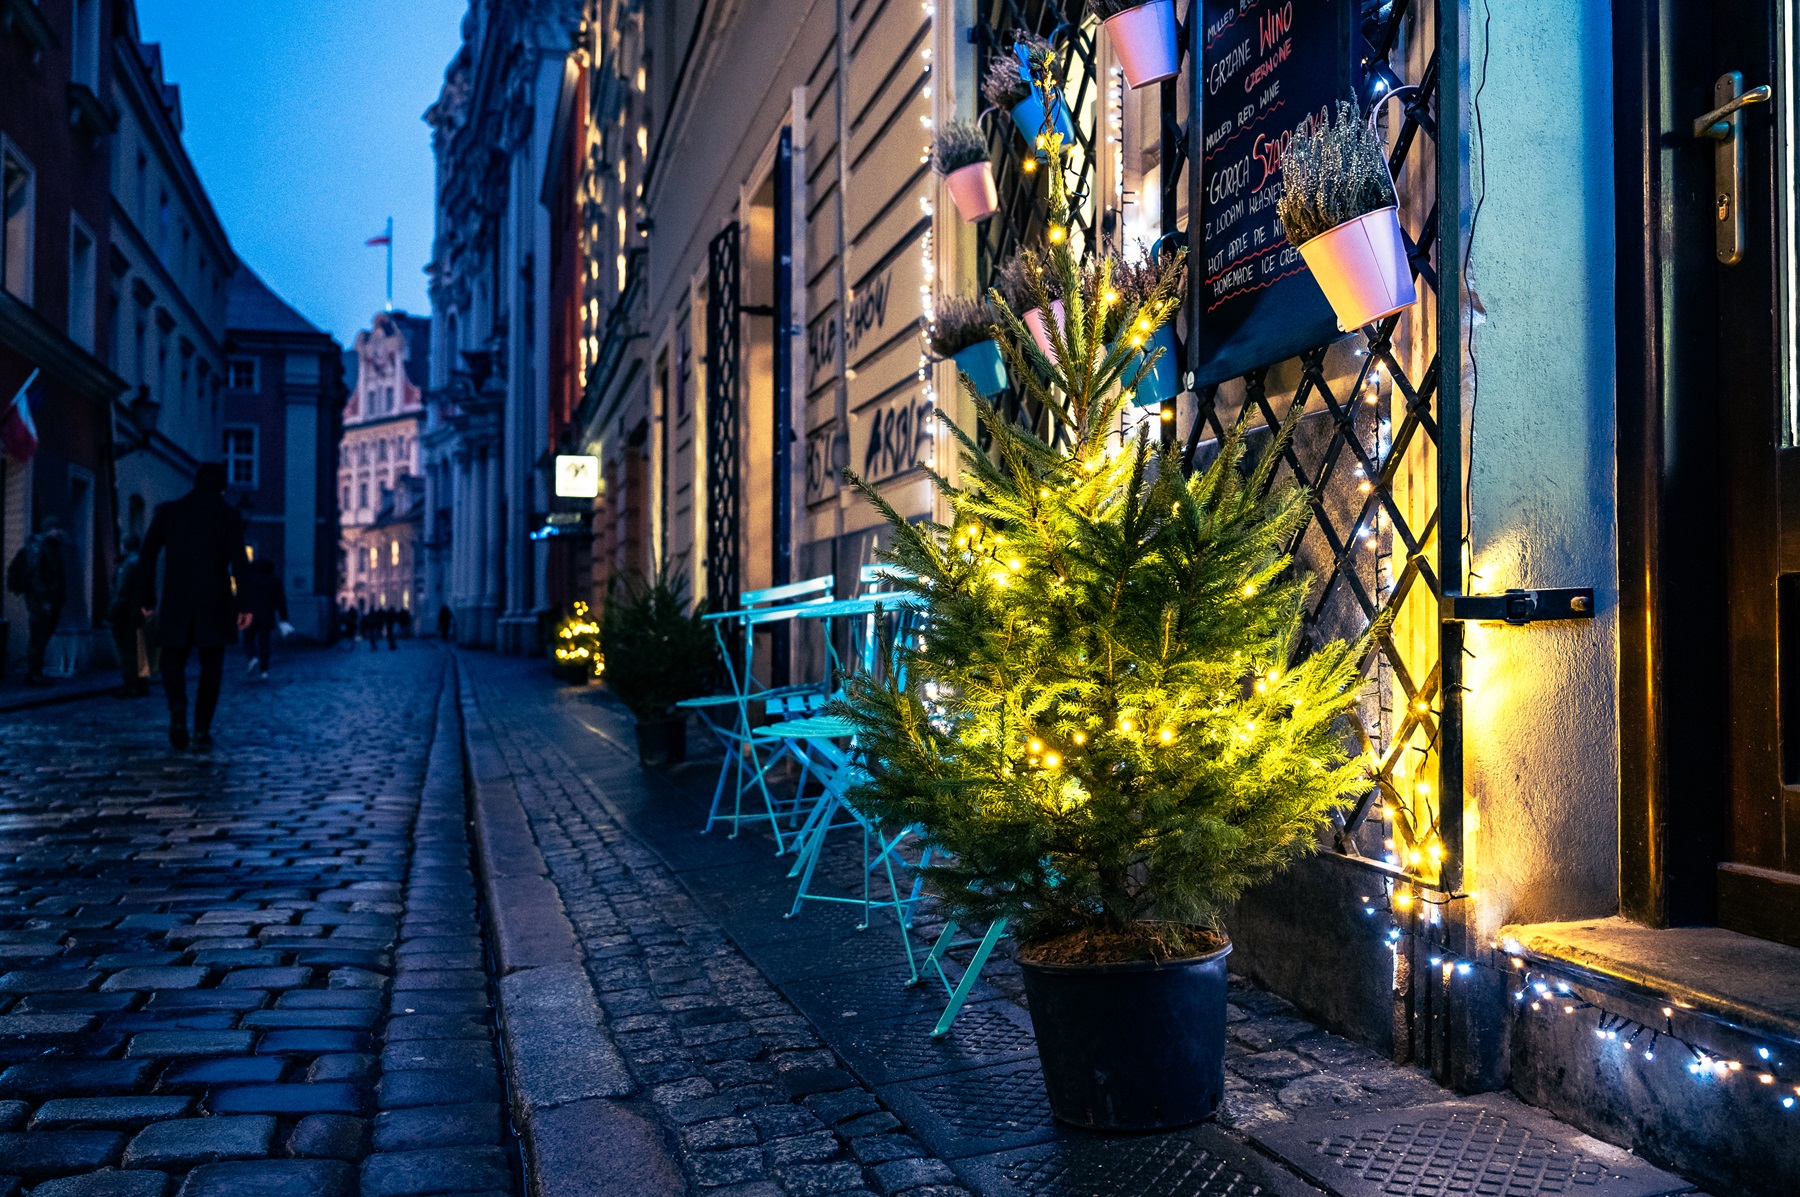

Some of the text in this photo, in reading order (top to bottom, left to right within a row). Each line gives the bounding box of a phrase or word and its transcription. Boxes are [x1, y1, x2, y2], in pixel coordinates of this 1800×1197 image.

[1207, 7, 1235, 42] MULLED
[1209, 1, 1293, 95] GRZANE WINO
[1244, 37, 1292, 93] CZERWONE
[1206, 80, 1281, 152] MULLED RED WINE
[1209, 155, 1250, 205] GORĄCA
[1205, 222, 1213, 242] Z
[1216, 199, 1245, 235] LODAMI
[1207, 249, 1224, 276] HOT
[1228, 232, 1249, 261] APPLE
[1253, 226, 1267, 247] PIE
[1213, 264, 1254, 297] HOMEMADE
[1261, 254, 1276, 275] ICE
